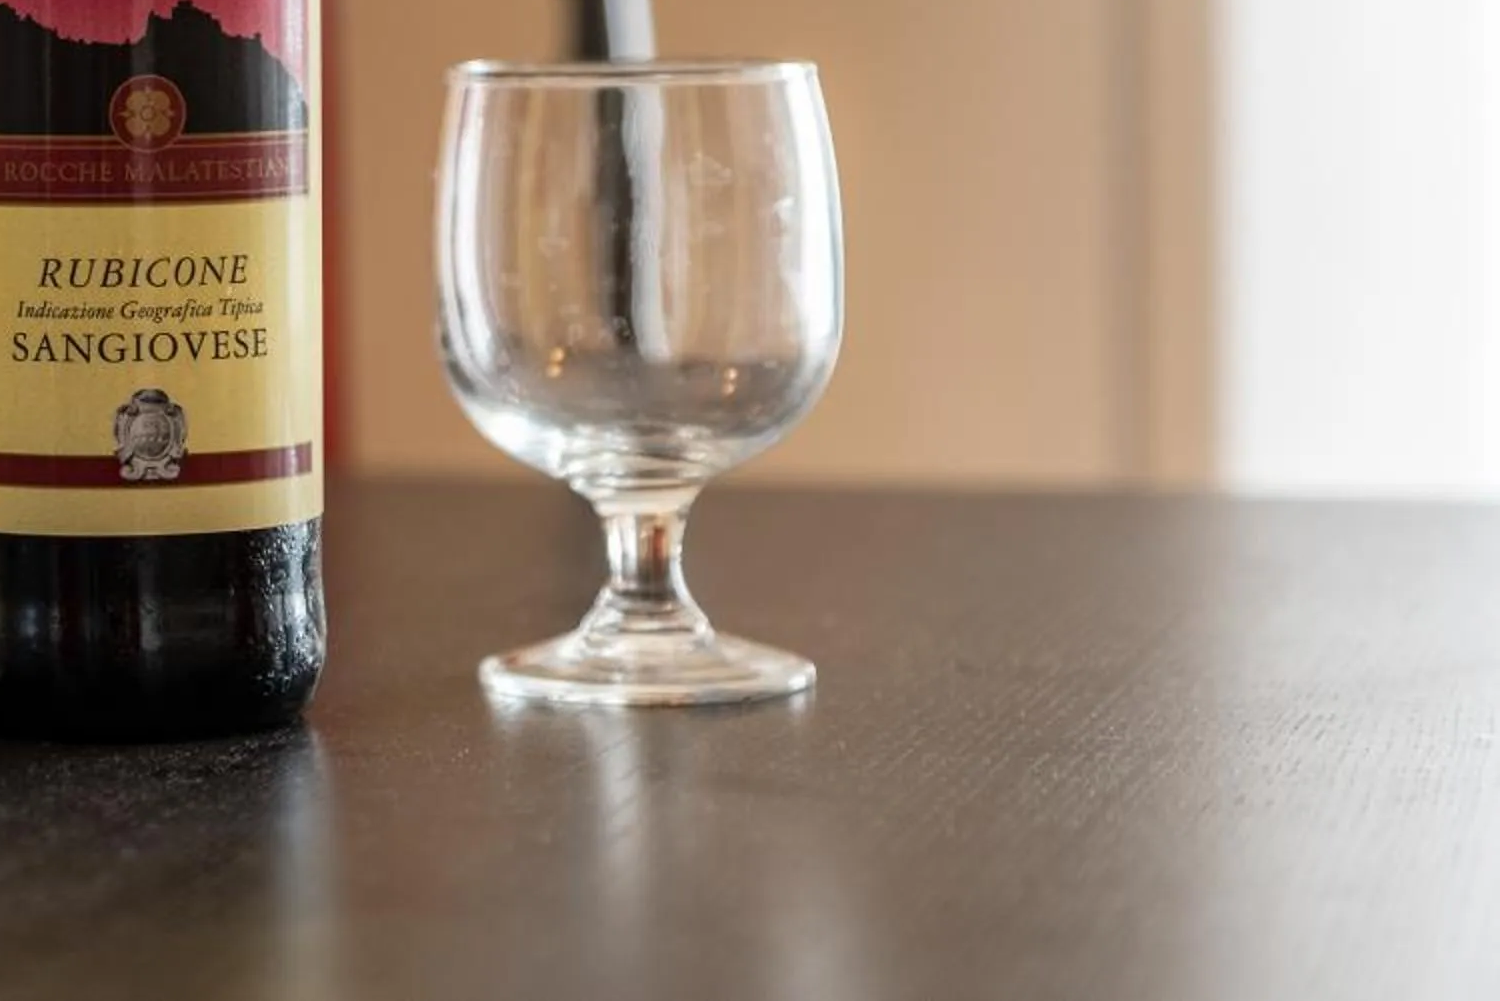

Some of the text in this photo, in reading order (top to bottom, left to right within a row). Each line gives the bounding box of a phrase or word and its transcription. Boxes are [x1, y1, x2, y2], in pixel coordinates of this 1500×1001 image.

[4, 161, 115, 183] ROCCHE
[124, 156, 299, 183] MALATESTIAN
[37, 254, 250, 290] RUBICONE
[16, 297, 265, 324] Indicazione Geografica Tipica
[11, 328, 269, 365] SANGIOVESE
